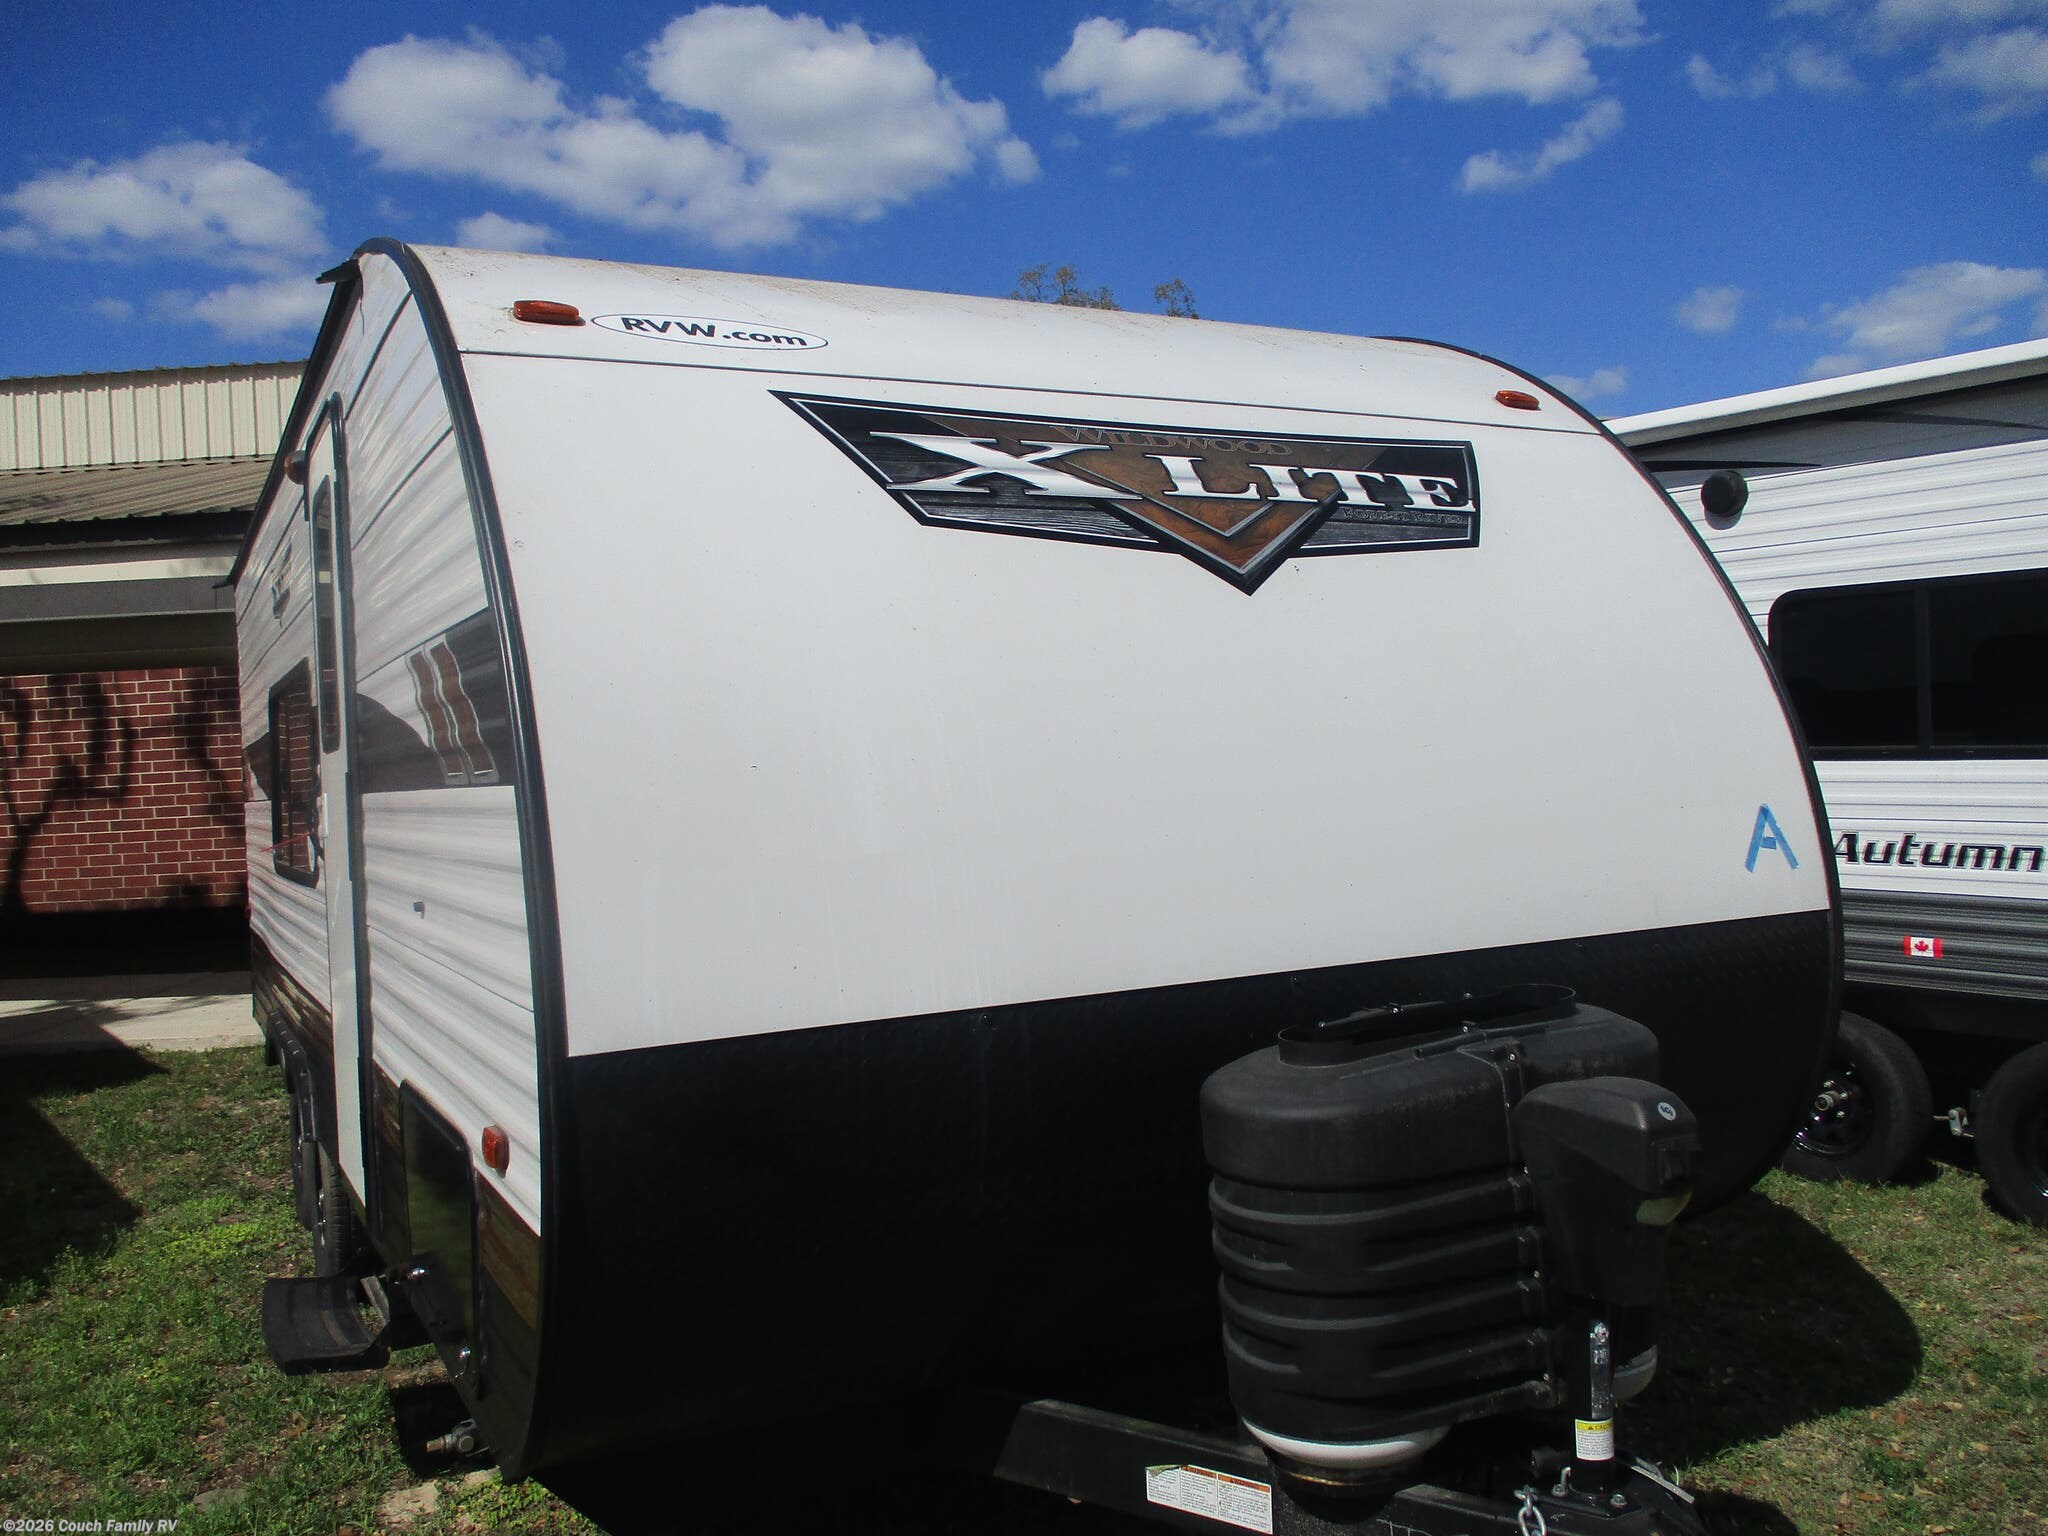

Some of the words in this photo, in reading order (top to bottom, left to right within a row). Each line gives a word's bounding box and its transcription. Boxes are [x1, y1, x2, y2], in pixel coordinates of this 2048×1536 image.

[621, 316, 808, 347] RVW.com
[1050, 426, 1293, 456] WILDWOOD
[869, 431, 1143, 500] X
[1146, 453, 1476, 512] LITE
[1744, 803, 1799, 873] A
[1834, 831, 2048, 873] Autumn
